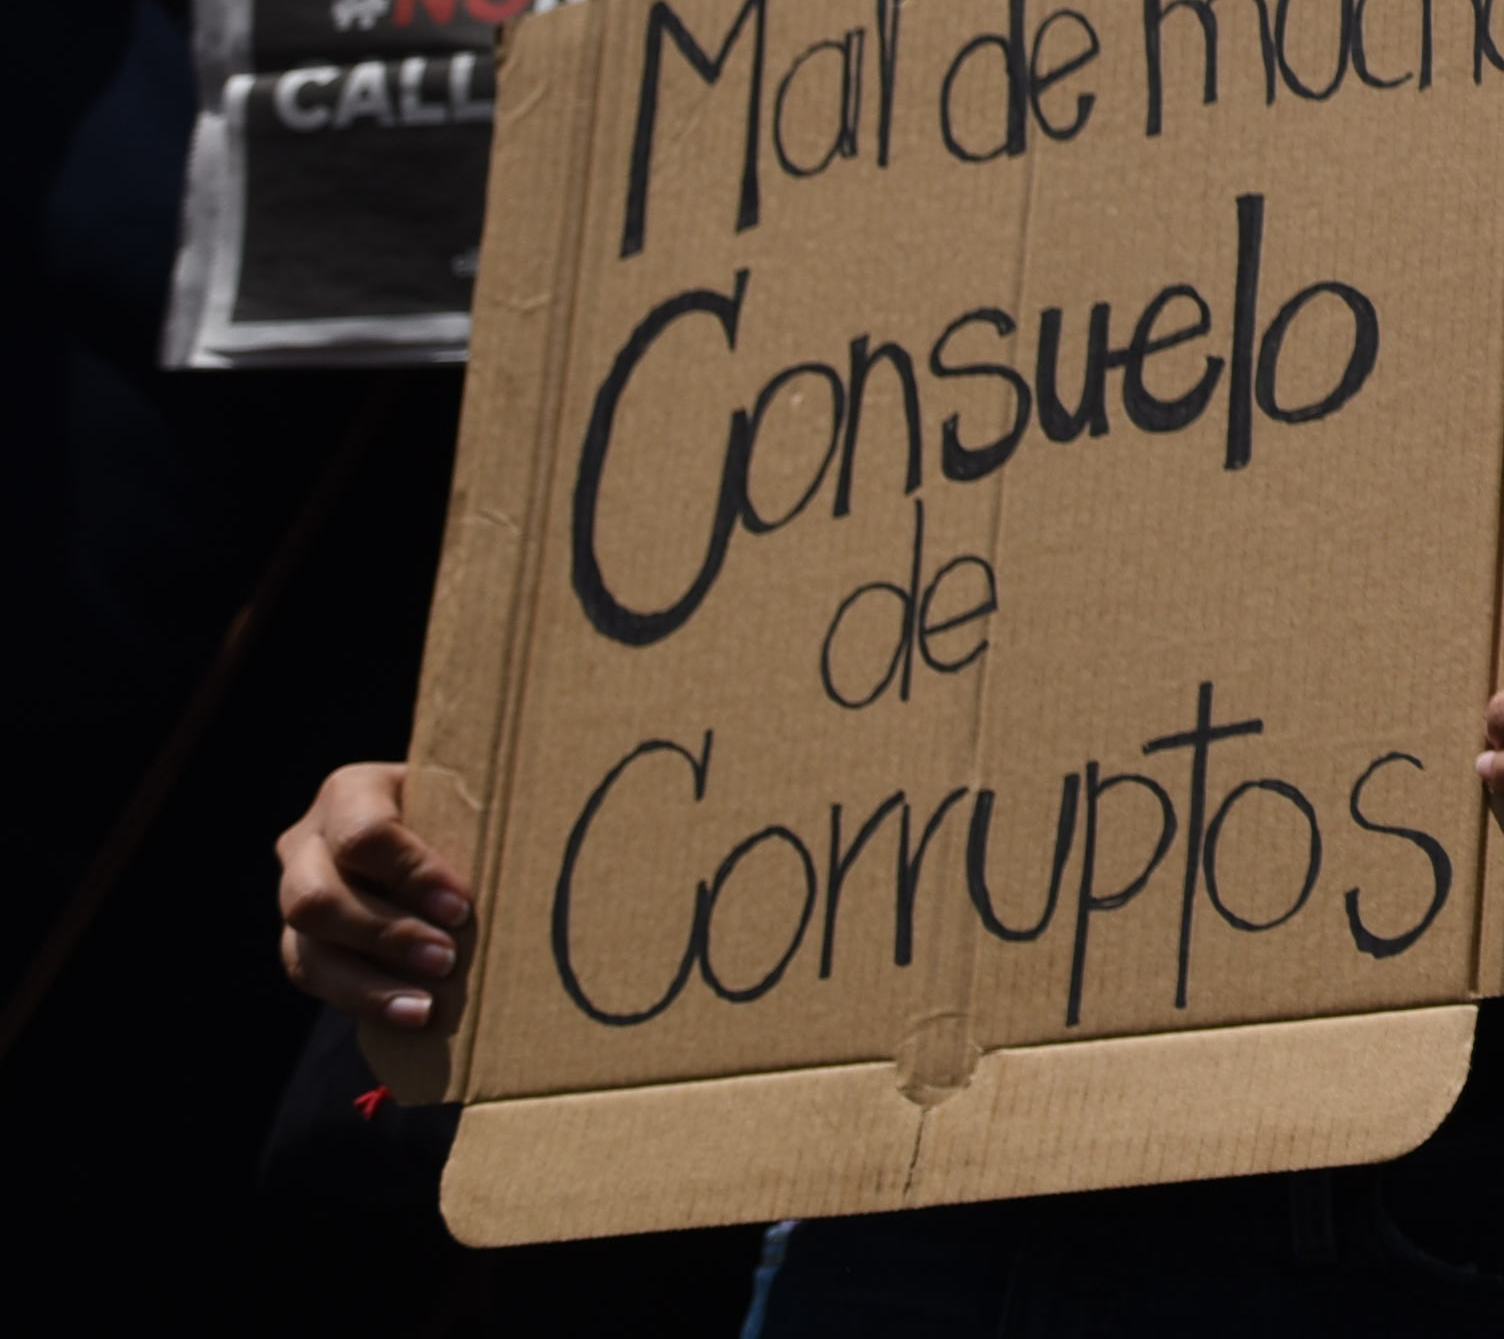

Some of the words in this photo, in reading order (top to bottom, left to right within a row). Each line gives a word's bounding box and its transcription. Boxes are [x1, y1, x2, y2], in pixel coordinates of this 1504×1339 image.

[570, 194, 1380, 646] Consuelo
[820, 497, 999, 709] de
[550, 680, 1452, 1028] Corruptos
